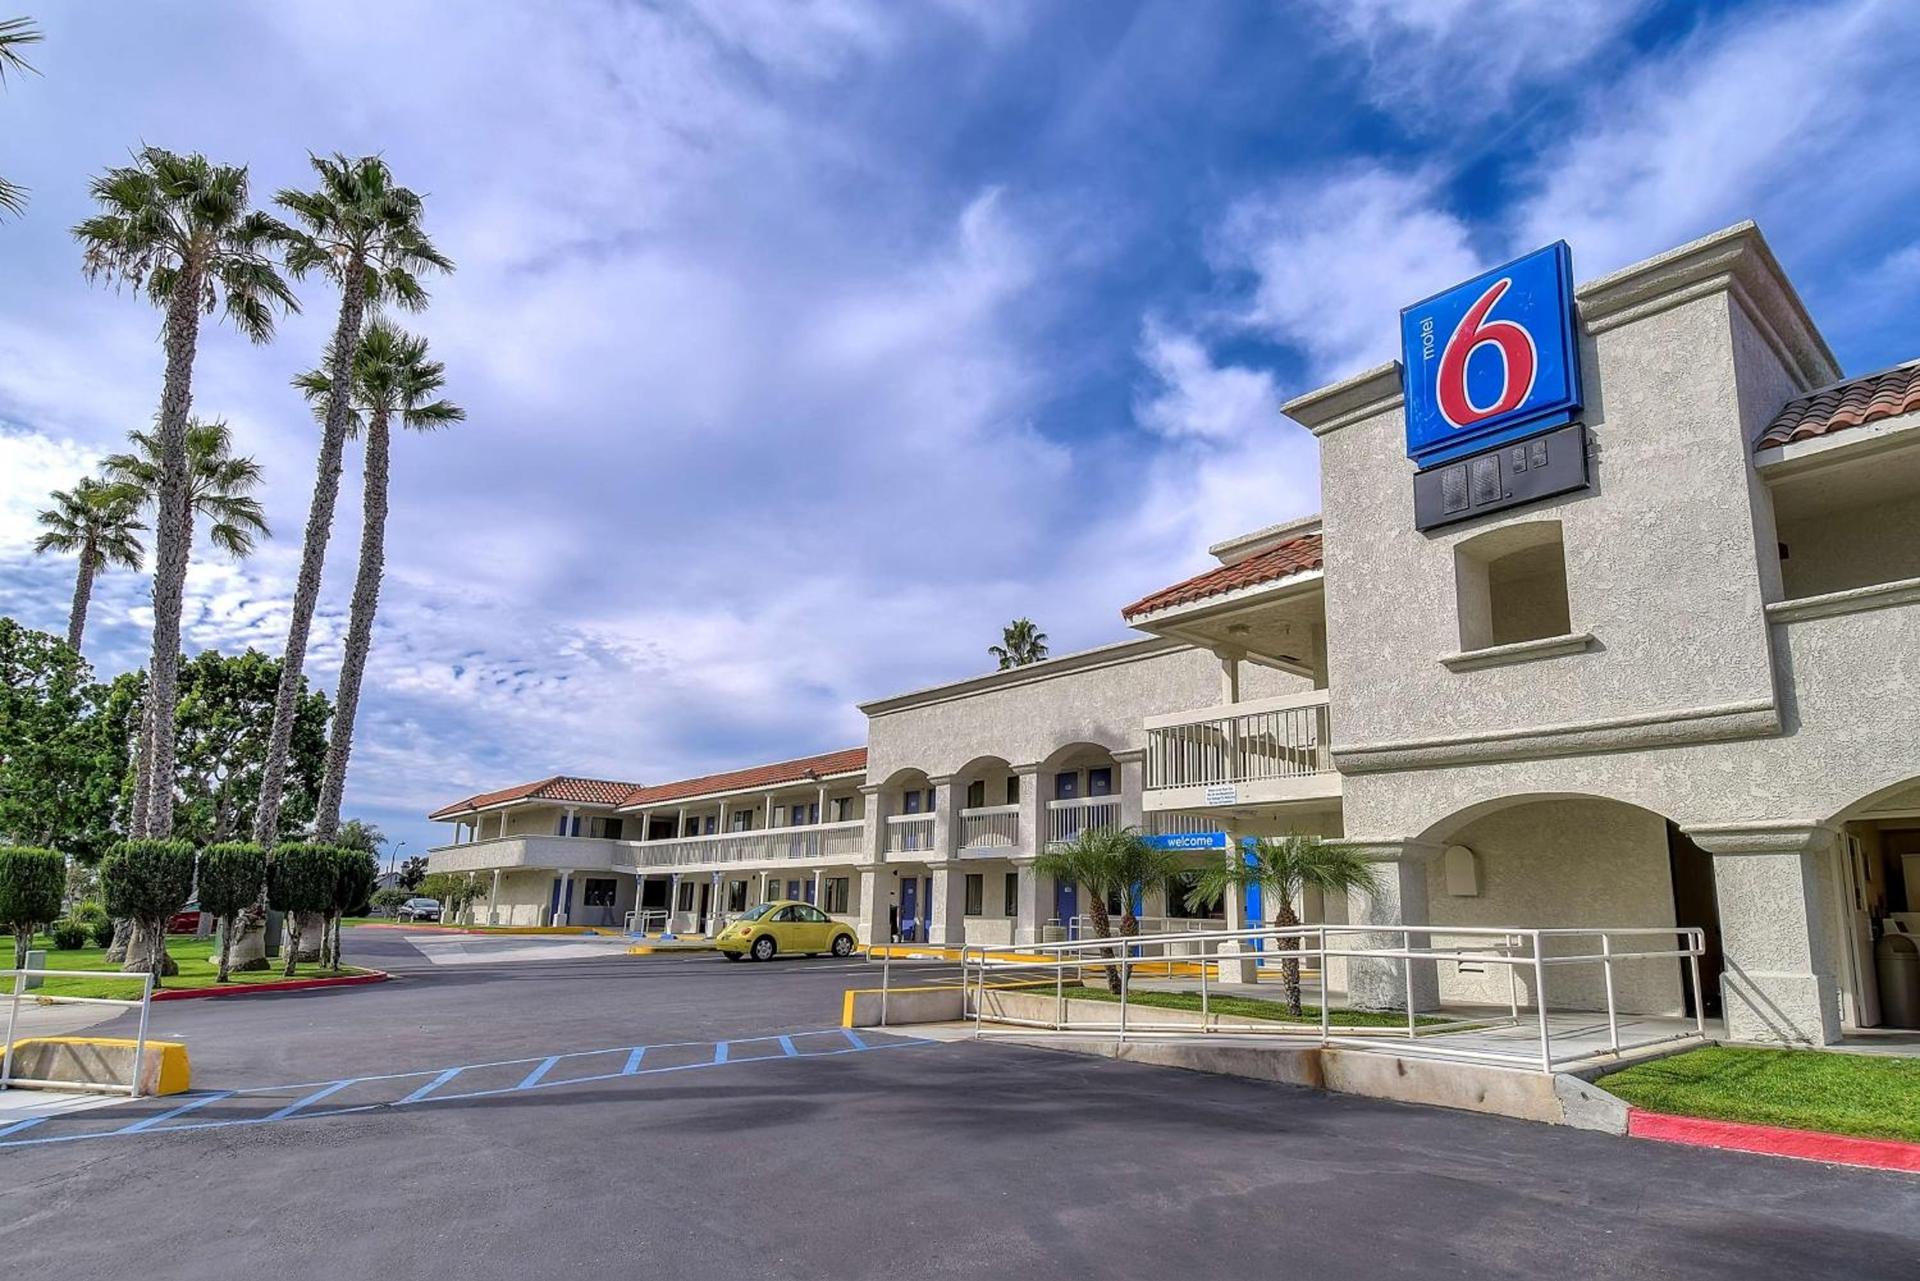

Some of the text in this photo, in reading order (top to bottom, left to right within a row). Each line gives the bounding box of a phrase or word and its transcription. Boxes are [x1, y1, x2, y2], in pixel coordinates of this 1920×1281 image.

[1420, 316, 1435, 360] motel
[1436, 277, 1538, 429] 6
[1168, 835, 1213, 847] welcome
